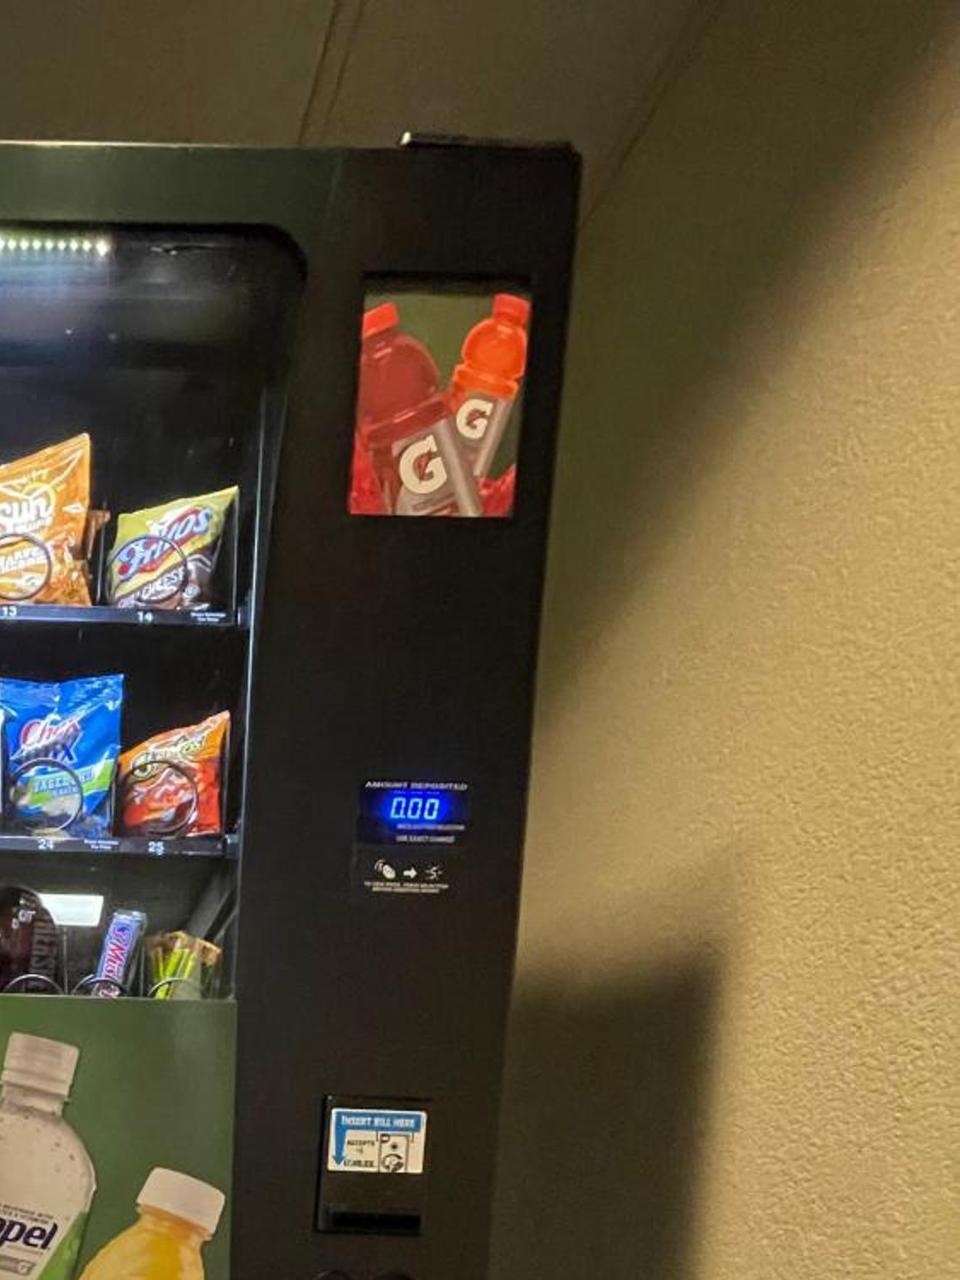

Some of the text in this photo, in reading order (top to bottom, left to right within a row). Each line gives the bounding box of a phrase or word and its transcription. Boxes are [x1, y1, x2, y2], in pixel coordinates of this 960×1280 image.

[456, 399, 493, 440] G
[400, 435, 447, 493] G
[2, 607, 17, 617] 13
[38, 839, 53, 850] 24
[149, 842, 164, 854] 25
